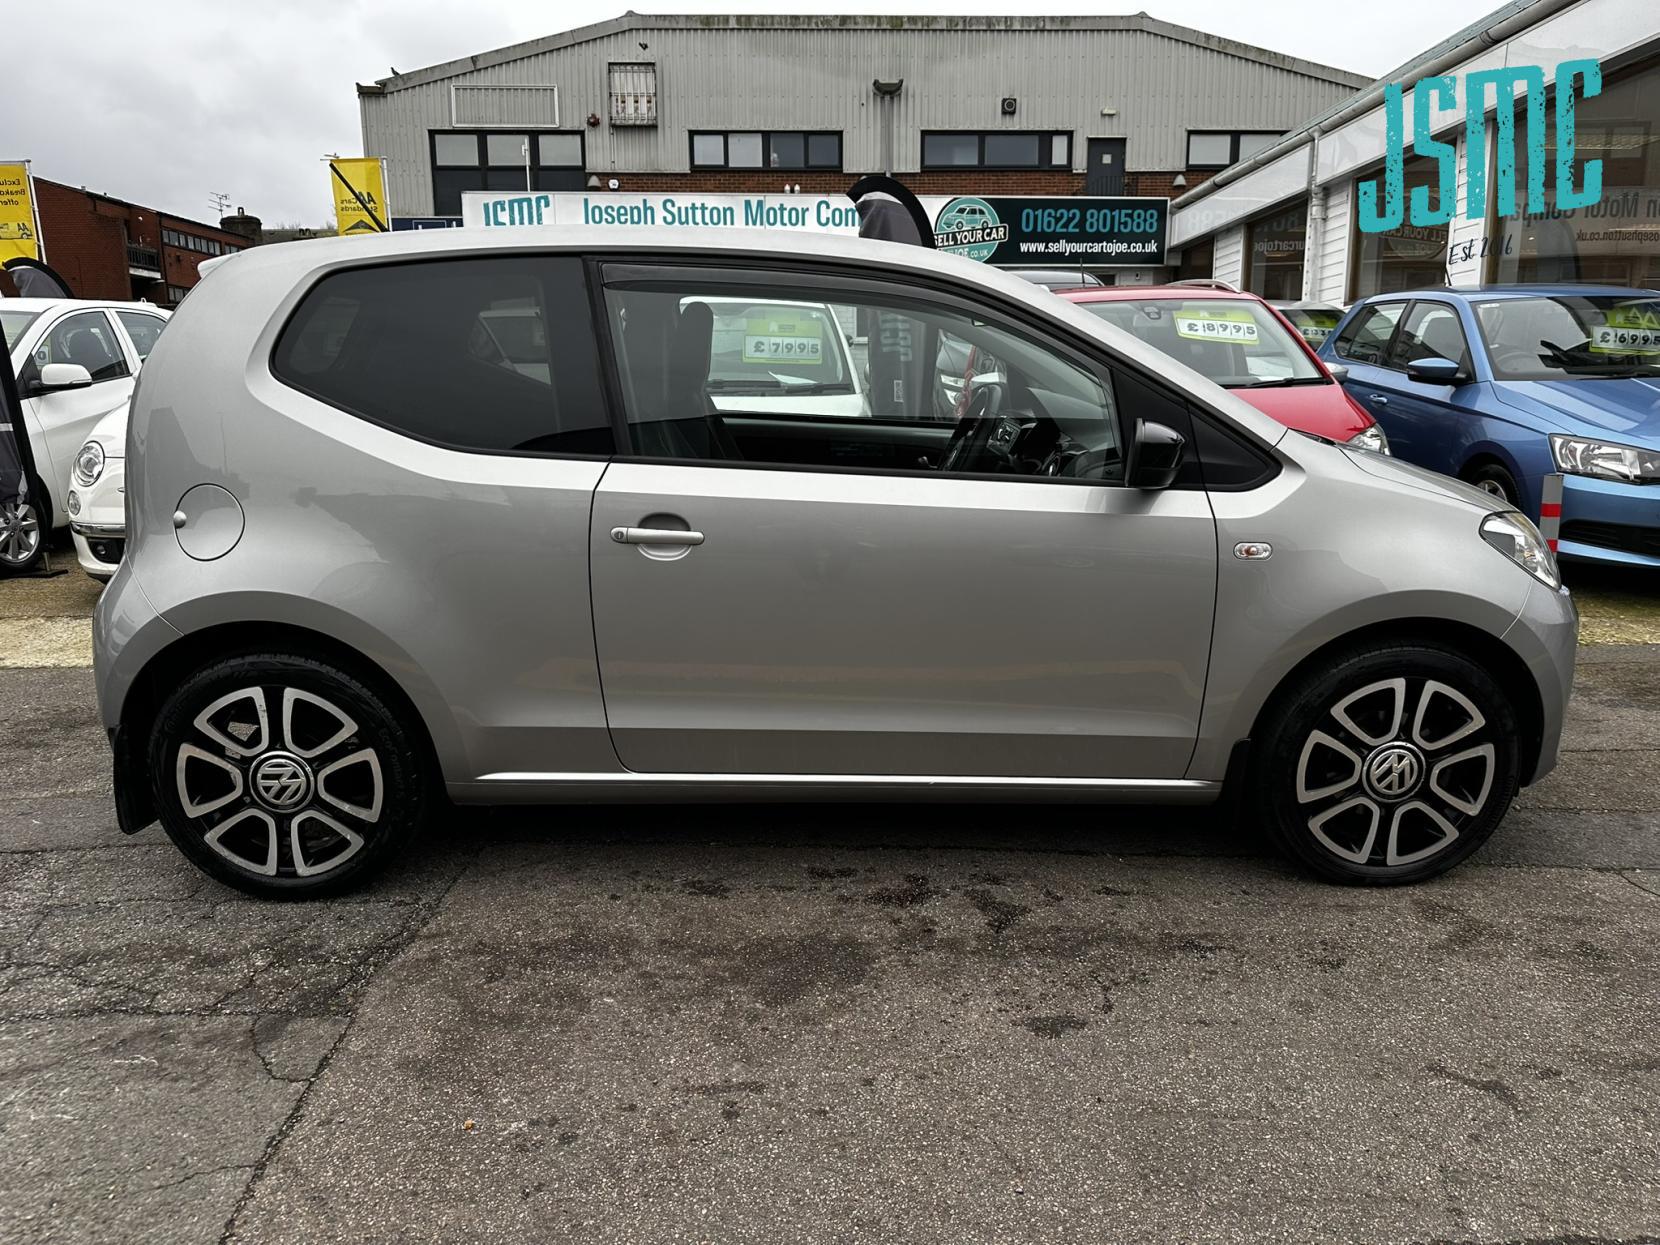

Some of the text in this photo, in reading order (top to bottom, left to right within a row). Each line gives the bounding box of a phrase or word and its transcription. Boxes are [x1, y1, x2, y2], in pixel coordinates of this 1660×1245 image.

[662, 199, 735, 226] Sutton
[744, 199, 809, 227] Motor
[1021, 208, 1158, 234] 01622 801588
[956, 230, 983, 244] YOUR
[983, 227, 1005, 240] CAR
[1020, 239, 1158, 256] www.sellyourcartojoe.co.uk
[753, 340, 819, 354] £7995
